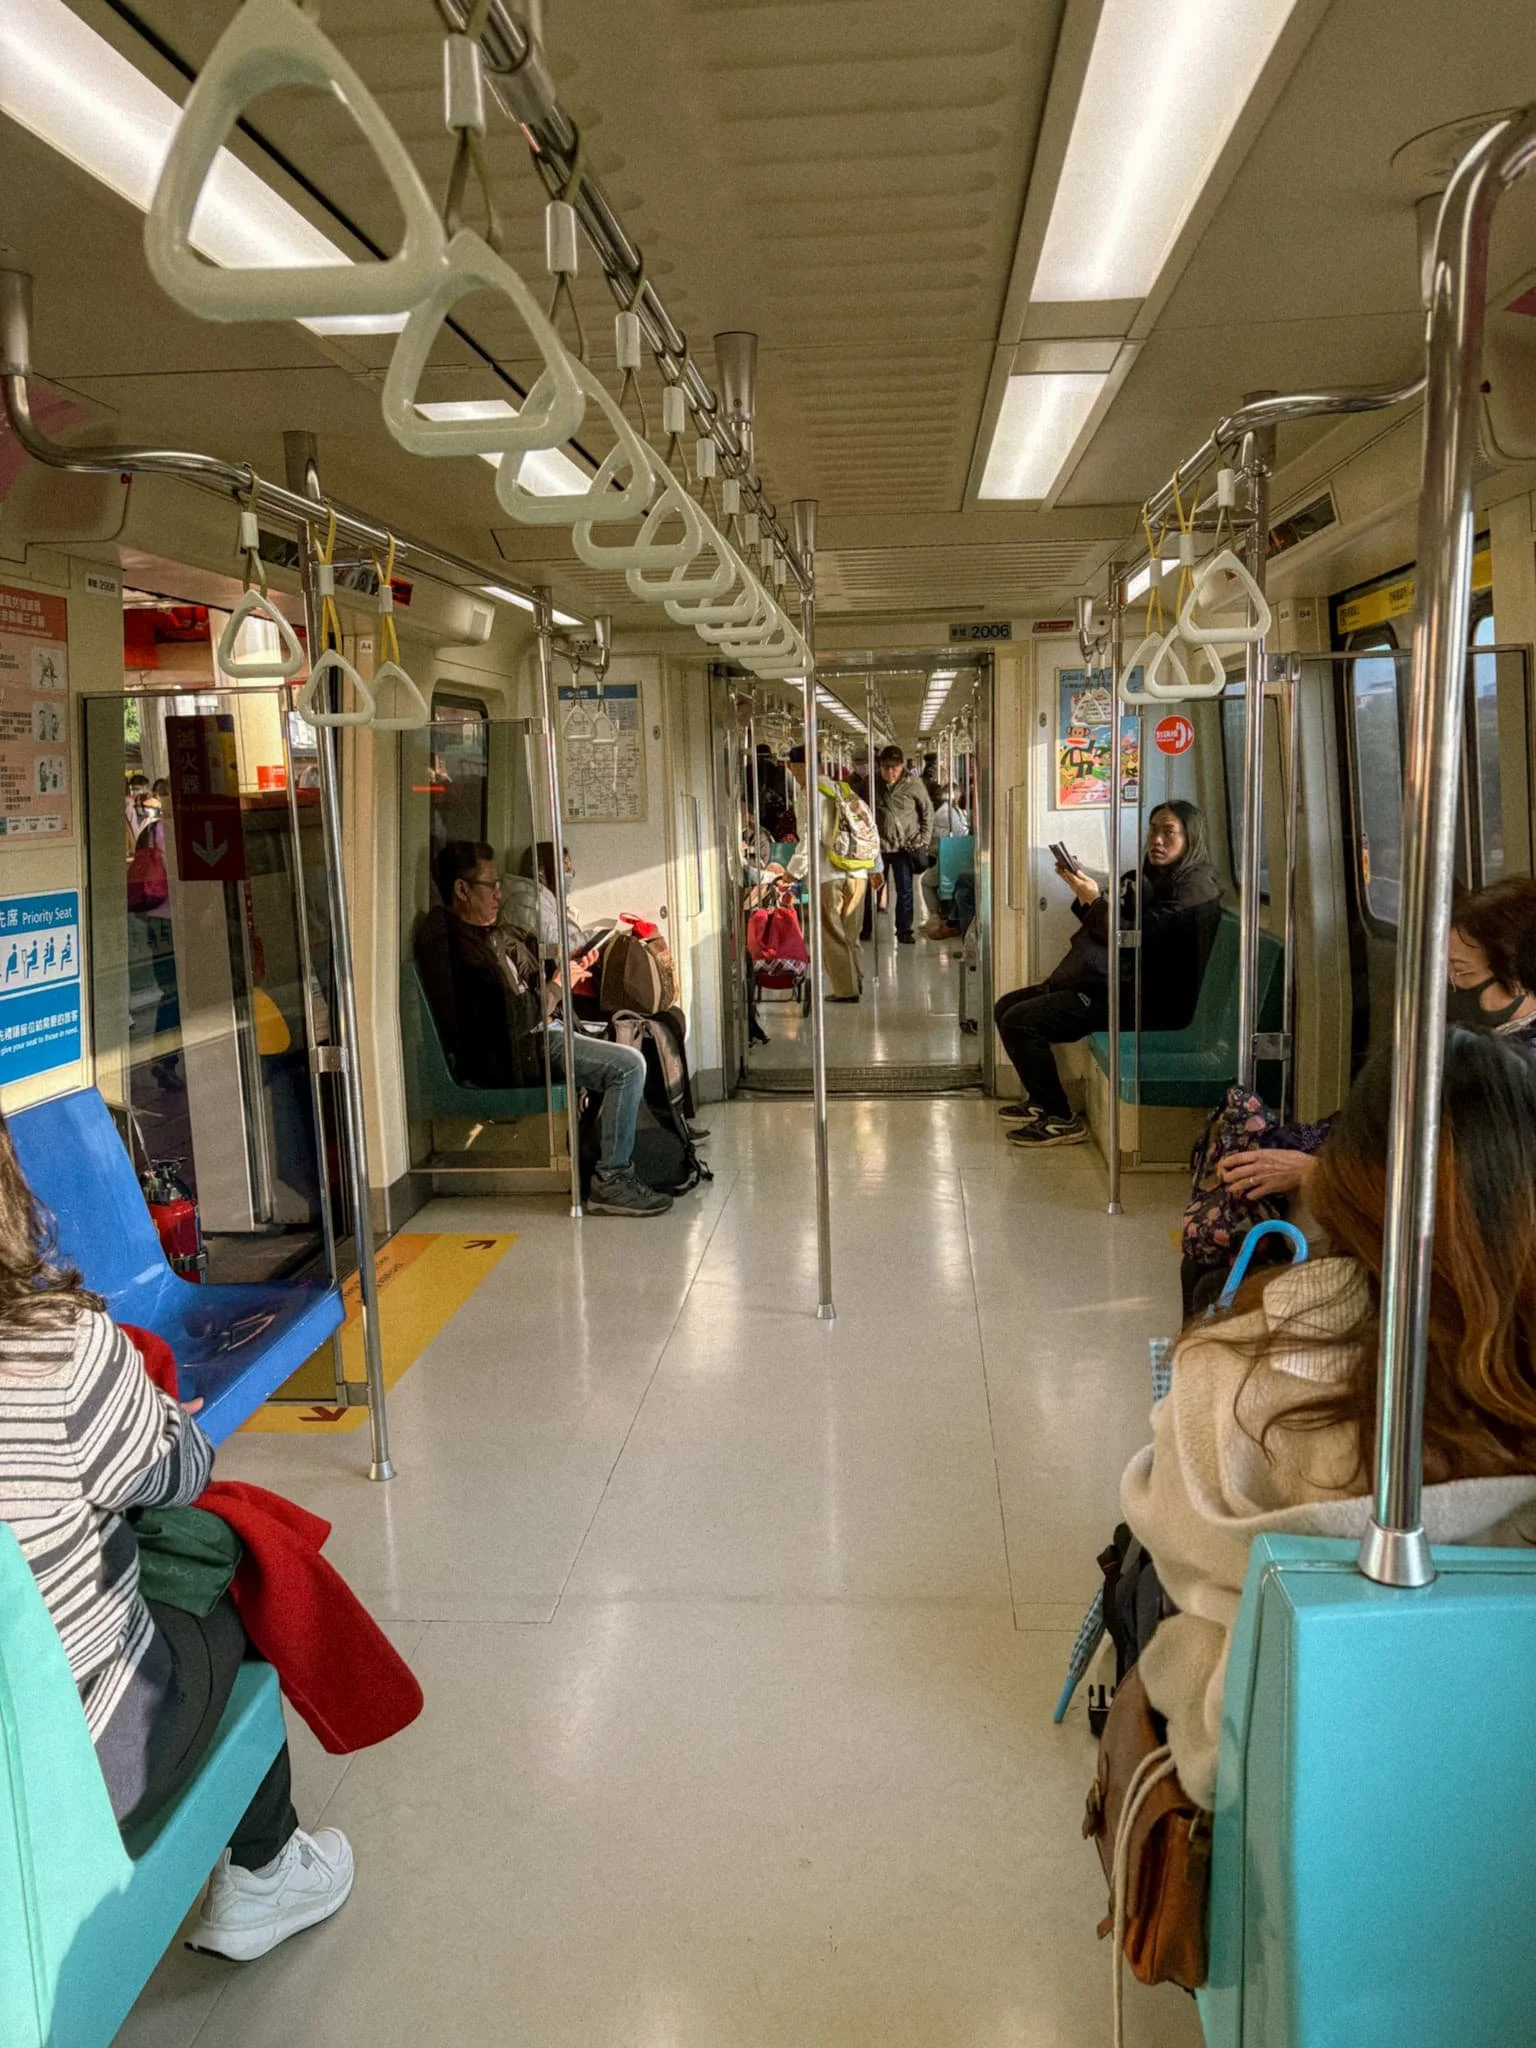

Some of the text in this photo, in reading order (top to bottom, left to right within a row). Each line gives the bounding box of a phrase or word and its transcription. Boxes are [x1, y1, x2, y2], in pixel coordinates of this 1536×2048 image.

[971, 624, 1010, 639] 2006
[22, 910, 53, 926] Priority
[55, 906, 73, 920] Seat
[12, 1042, 25, 1054] your
[25, 1038, 37, 1048] seat
[44, 1032, 59, 1042] those
